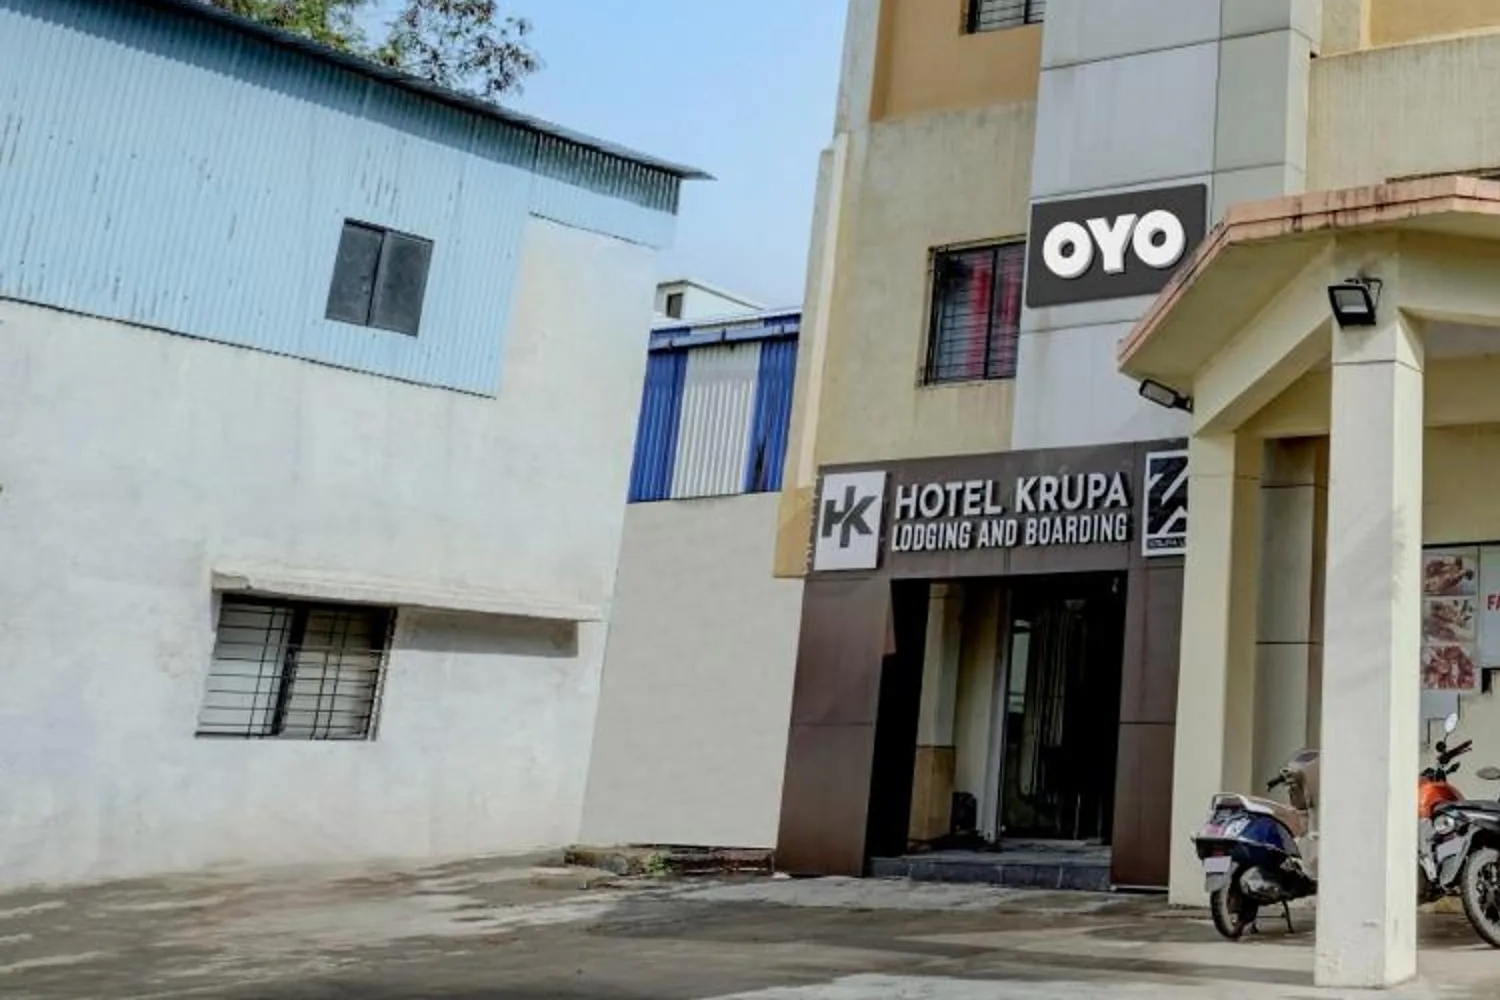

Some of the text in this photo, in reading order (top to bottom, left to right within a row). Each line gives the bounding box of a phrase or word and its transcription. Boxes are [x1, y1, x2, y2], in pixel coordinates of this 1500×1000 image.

[1043, 209, 1187, 279] OYO
[895, 472, 1128, 519] HOTEL KRUPA
[891, 512, 1128, 551] LODGING AND BOARDING
